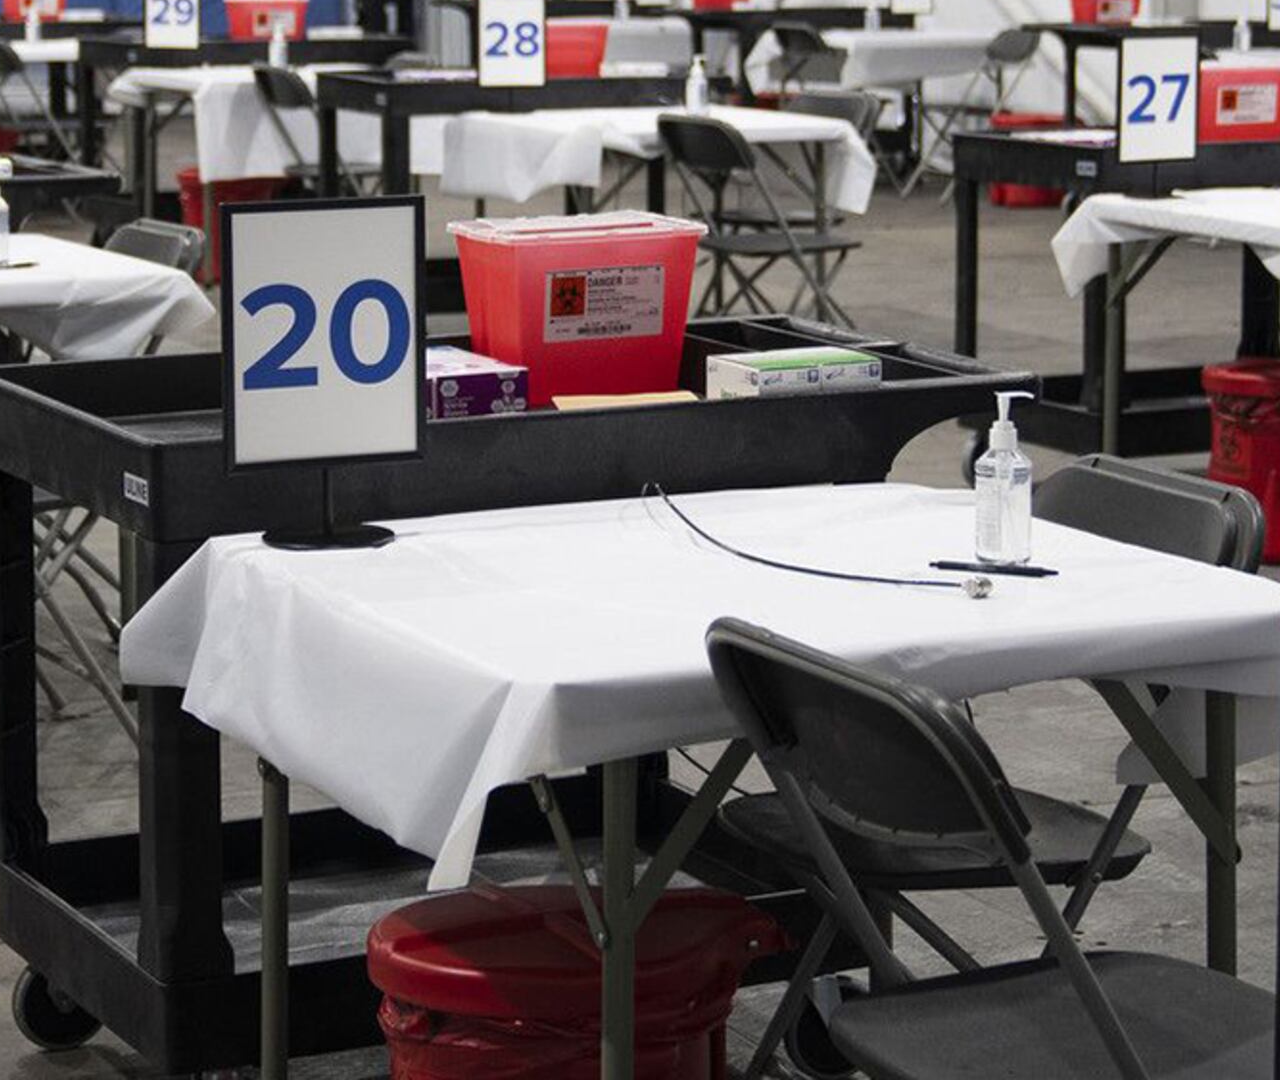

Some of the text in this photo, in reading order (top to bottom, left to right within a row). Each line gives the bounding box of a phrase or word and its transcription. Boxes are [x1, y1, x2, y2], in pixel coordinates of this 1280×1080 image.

[485, 20, 540, 58] 28
[1127, 74, 1191, 125] 27
[239, 277, 412, 392] 20
